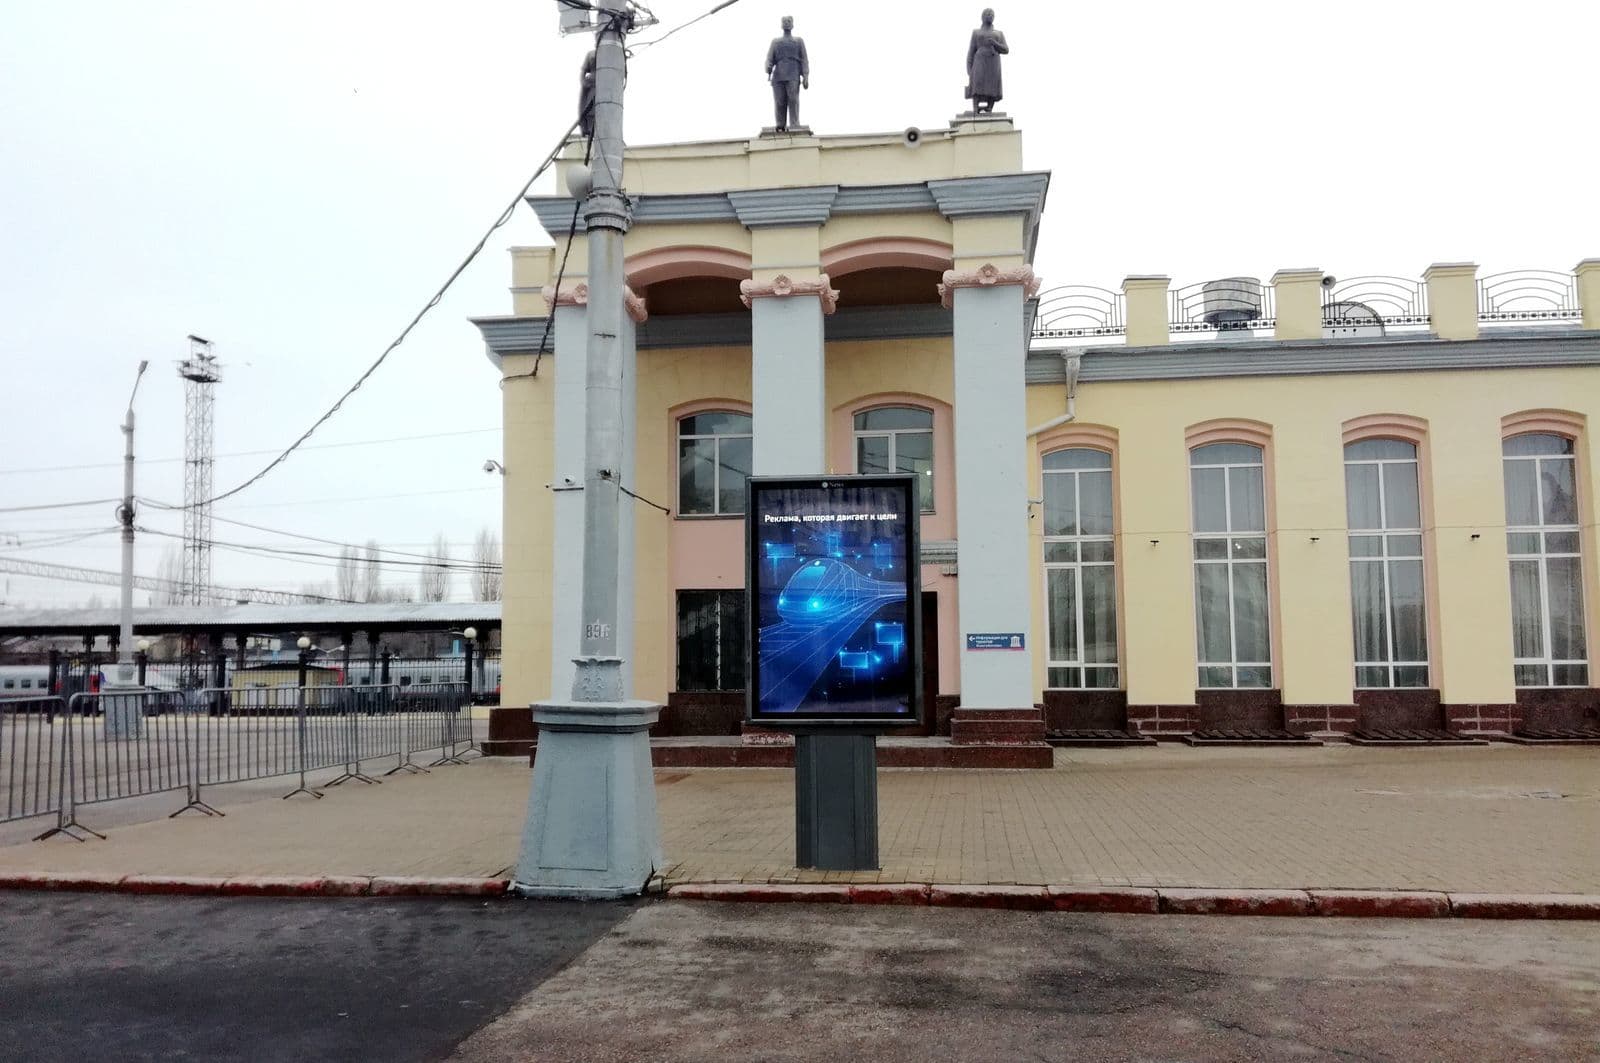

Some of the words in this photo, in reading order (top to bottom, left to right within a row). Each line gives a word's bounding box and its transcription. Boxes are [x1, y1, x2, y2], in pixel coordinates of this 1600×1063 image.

[764, 514, 801, 523] Реклама,
[803, 514, 835, 523] которая
[836, 514, 869, 522] двигает
[877, 513, 897, 521] цели
